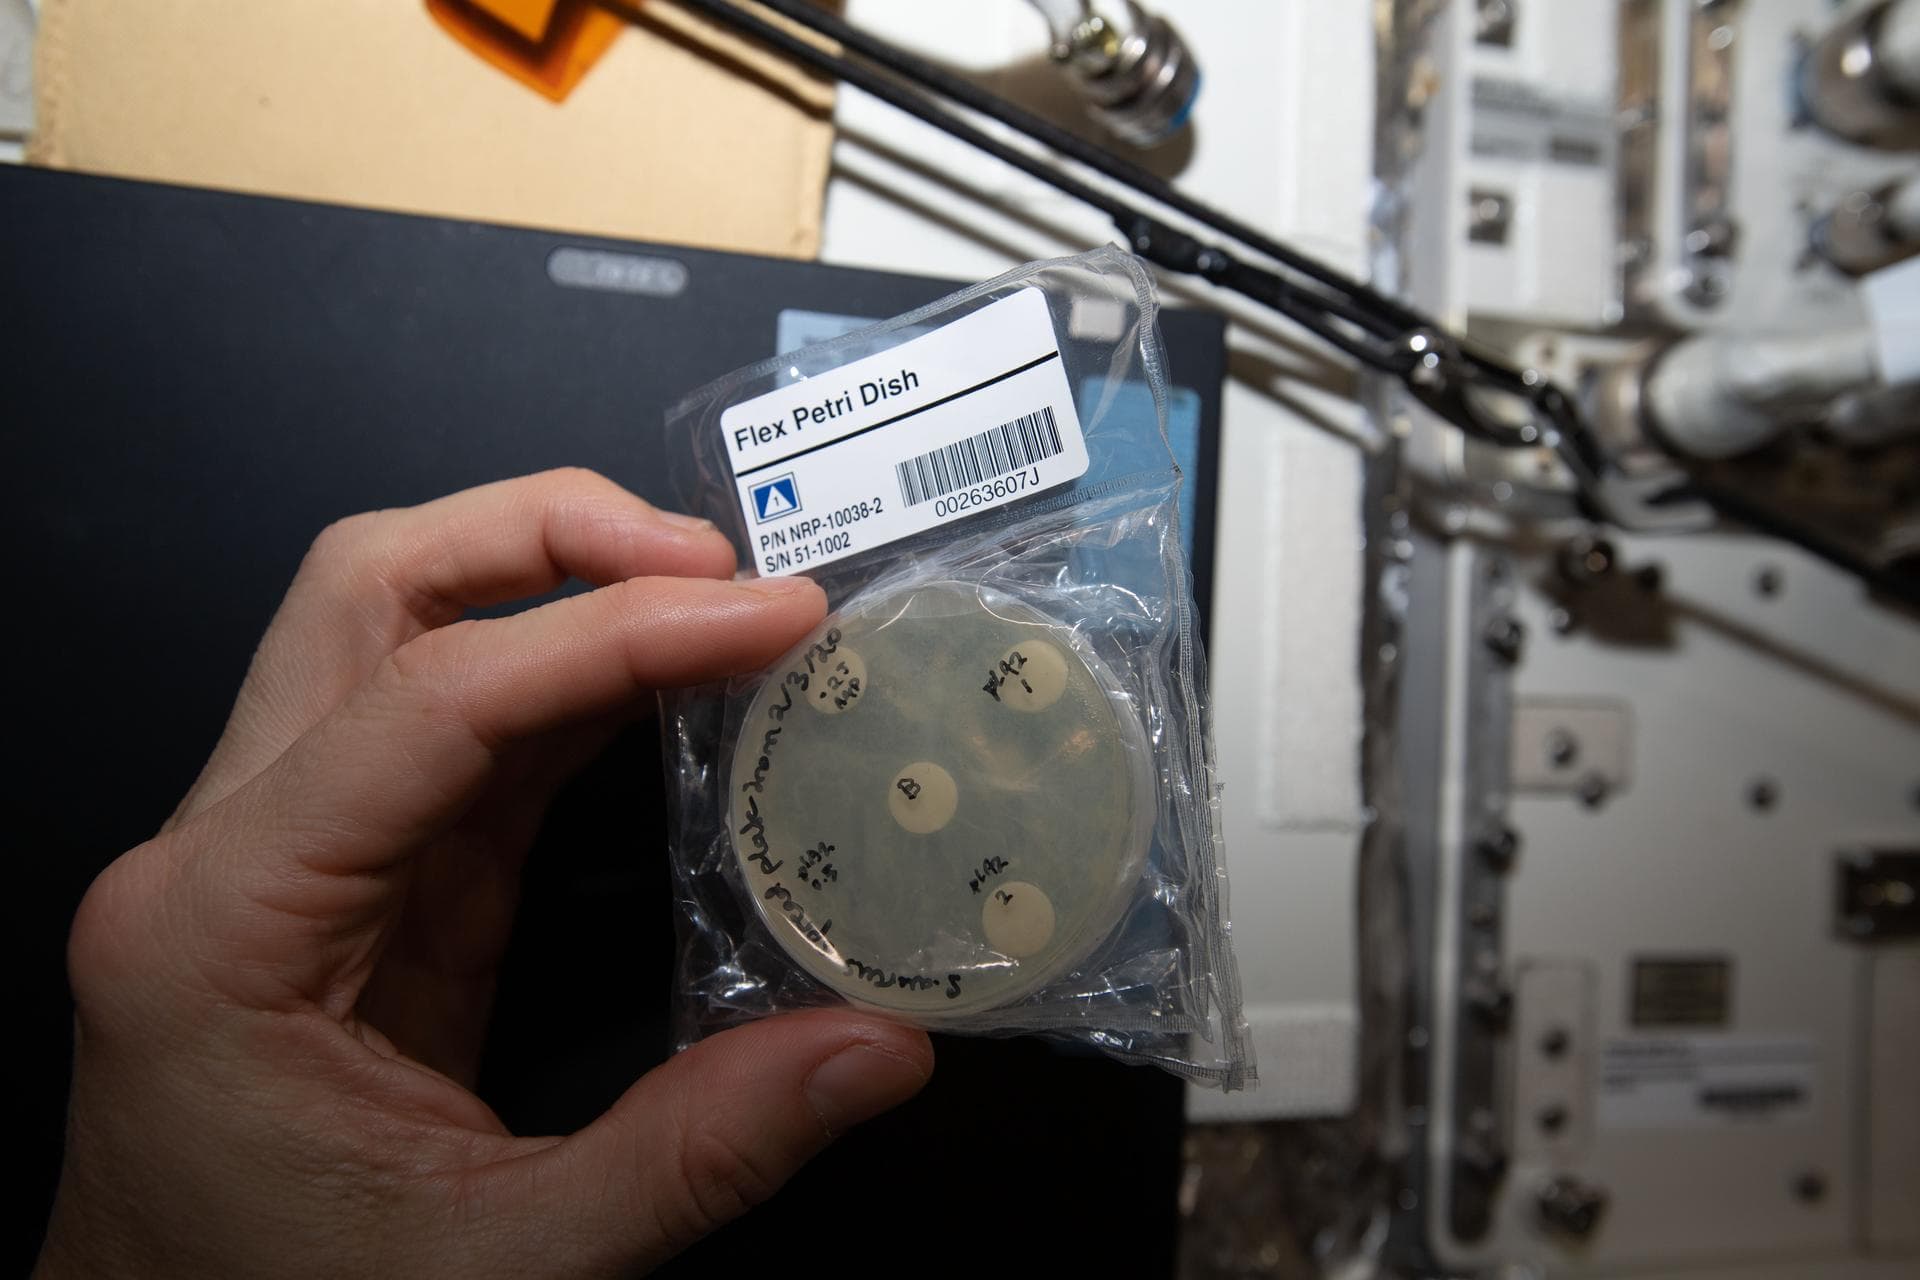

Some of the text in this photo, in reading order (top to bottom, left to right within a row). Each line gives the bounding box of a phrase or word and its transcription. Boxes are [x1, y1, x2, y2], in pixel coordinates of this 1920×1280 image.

[734, 368, 920, 452] Flex Petri Dish
[935, 467, 1040, 518] 00263607J
[760, 497, 884, 552] P/N NRP-10038-2
[765, 532, 851, 572] S/N 51-1002
[897, 777, 921, 800] B
[995, 889, 1014, 906] 2
